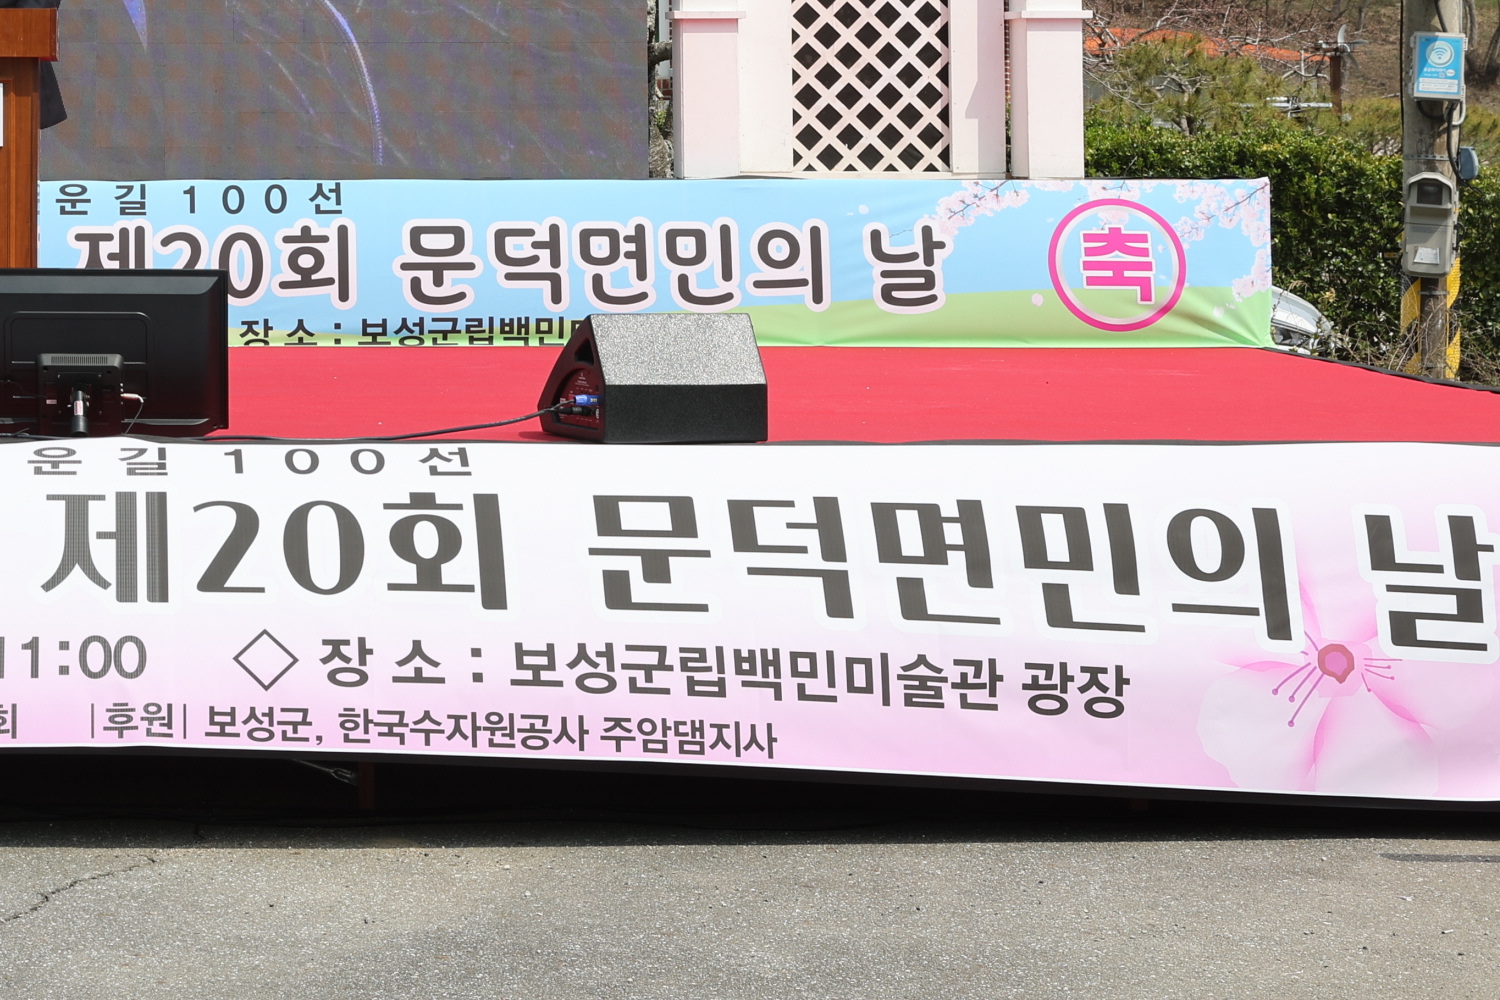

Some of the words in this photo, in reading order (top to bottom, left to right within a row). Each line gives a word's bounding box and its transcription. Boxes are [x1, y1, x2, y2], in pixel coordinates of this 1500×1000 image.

[401, 224, 822, 306] 문덕면민의
[871, 226, 945, 306] 날
[1084, 227, 1152, 302] 축
[41, 492, 507, 610] 제20회
[588, 495, 1292, 641] 문덕면민의
[1364, 514, 1495, 652] 날
[509, 642, 1004, 712] 보성군립백민미술관
[1021, 661, 1131, 719] 광장
[204, 705, 323, 746] 보성군,
[337, 707, 590, 752] 한국수자원공사
[600, 717, 778, 760] 주암댐지사
